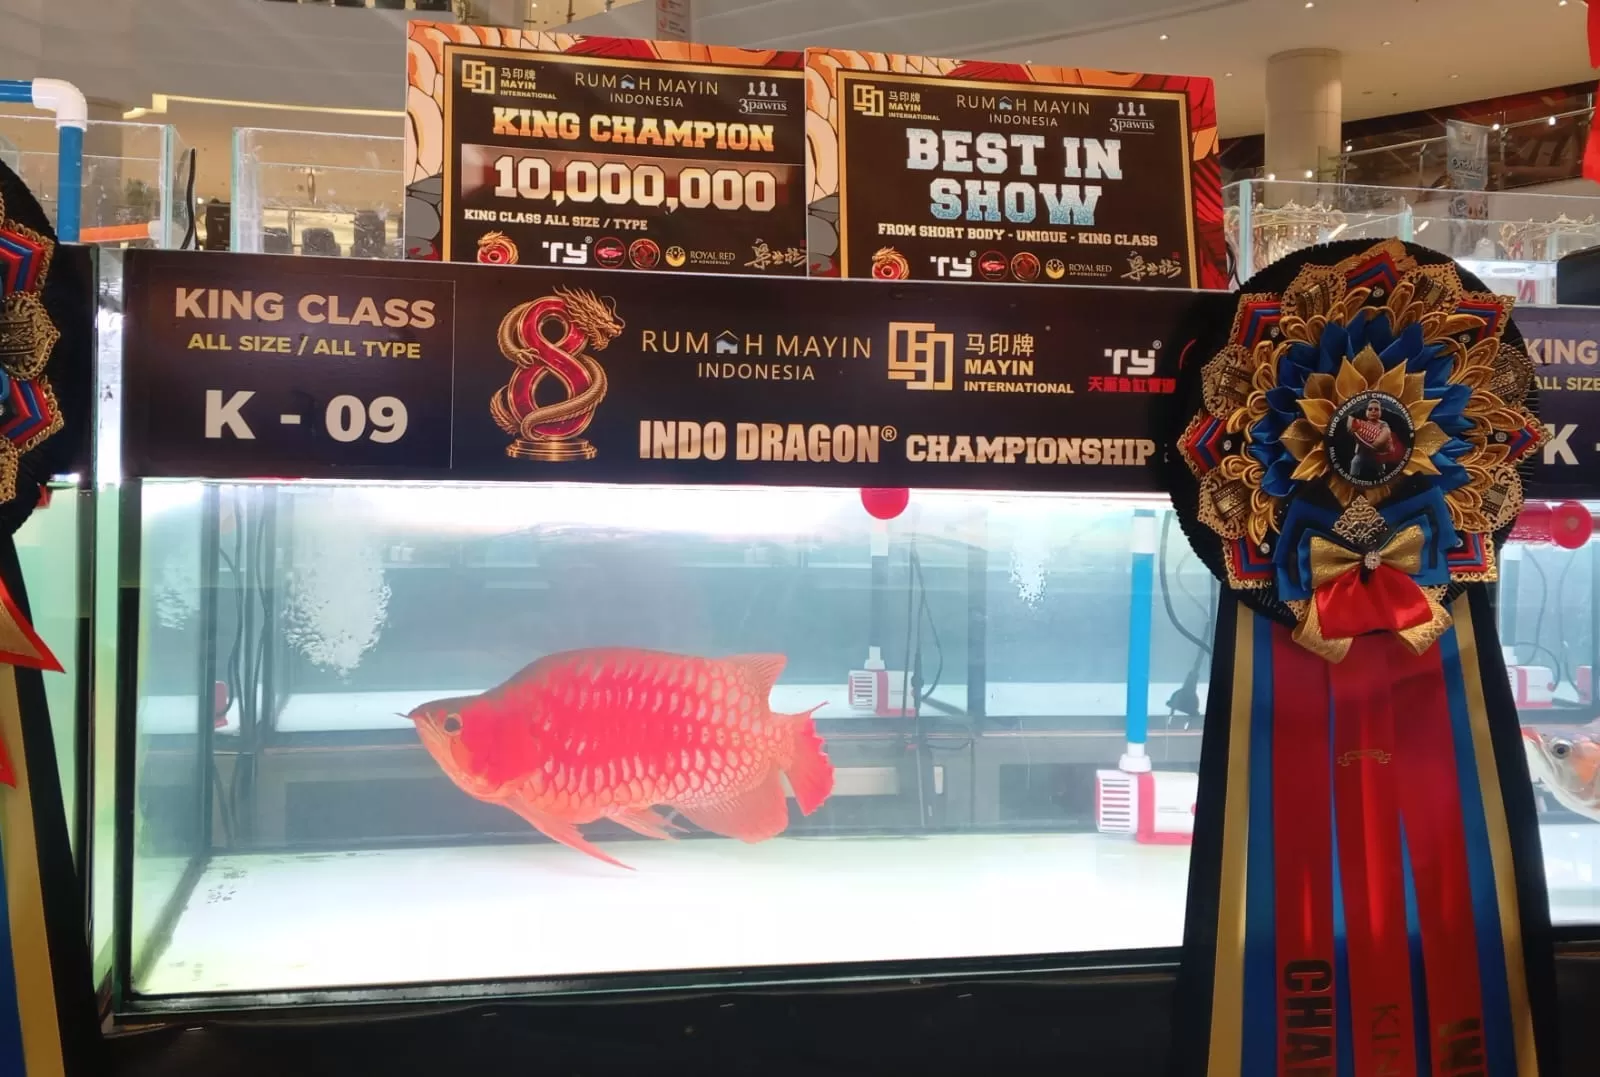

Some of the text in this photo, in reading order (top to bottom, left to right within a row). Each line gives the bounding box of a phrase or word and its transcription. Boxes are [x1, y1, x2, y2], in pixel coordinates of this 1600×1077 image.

[501, 79, 536, 90] MAYIN
[658, 78, 719, 96] MAYIN
[500, 90, 557, 100] INTERNATIONAL
[610, 93, 684, 107] INDONESIA
[739, 98, 788, 114] 3pawns
[888, 102, 921, 112] MAYIN
[1033, 99, 1090, 116] MAYIN
[888, 112, 941, 121] INTERNATIONAL
[989, 113, 1058, 127] INDONESIA
[1109, 117, 1155, 133] 3pawns
[492, 106, 775, 152] KING CHAMPION
[905, 127, 1123, 180] BEST IN
[494, 155, 776, 214] 10,000,000
[930, 177, 1102, 226] SHOW
[464, 209, 648, 230] KING CLASS ALL SIZE / TYPE
[878, 223, 916, 237] FROM
[919, 226, 964, 239] SHORT
[967, 227, 1005, 241] BODY
[1016, 230, 1067, 243] UNIQUE
[1078, 233, 1111, 246] KING
[1114, 234, 1158, 247] CLASS
[690, 250, 736, 261] ROYAL RED
[1069, 263, 1113, 273] ROYAL RED
[175, 288, 436, 329] KING CLASS
[187, 333, 421, 359] ALL SIZE / ALL TYPE
[776, 335, 872, 359] MAYIN
[965, 332, 1034, 357] 马印牌
[1525, 338, 1599, 365] KING
[698, 362, 816, 380] INDONESIA
[964, 358, 1034, 376] MAYIN
[963, 380, 1075, 394] INTERNATIONAL
[1534, 376, 1562, 391] ALL
[205, 389, 408, 443] K - 09
[1328, 416, 1340, 437] INDO
[639, 420, 727, 461] INDO
[905, 434, 1156, 466] CHAMPIONSHIP
[1543, 423, 1580, 465] K
[1284, 959, 1334, 1077] CHA
